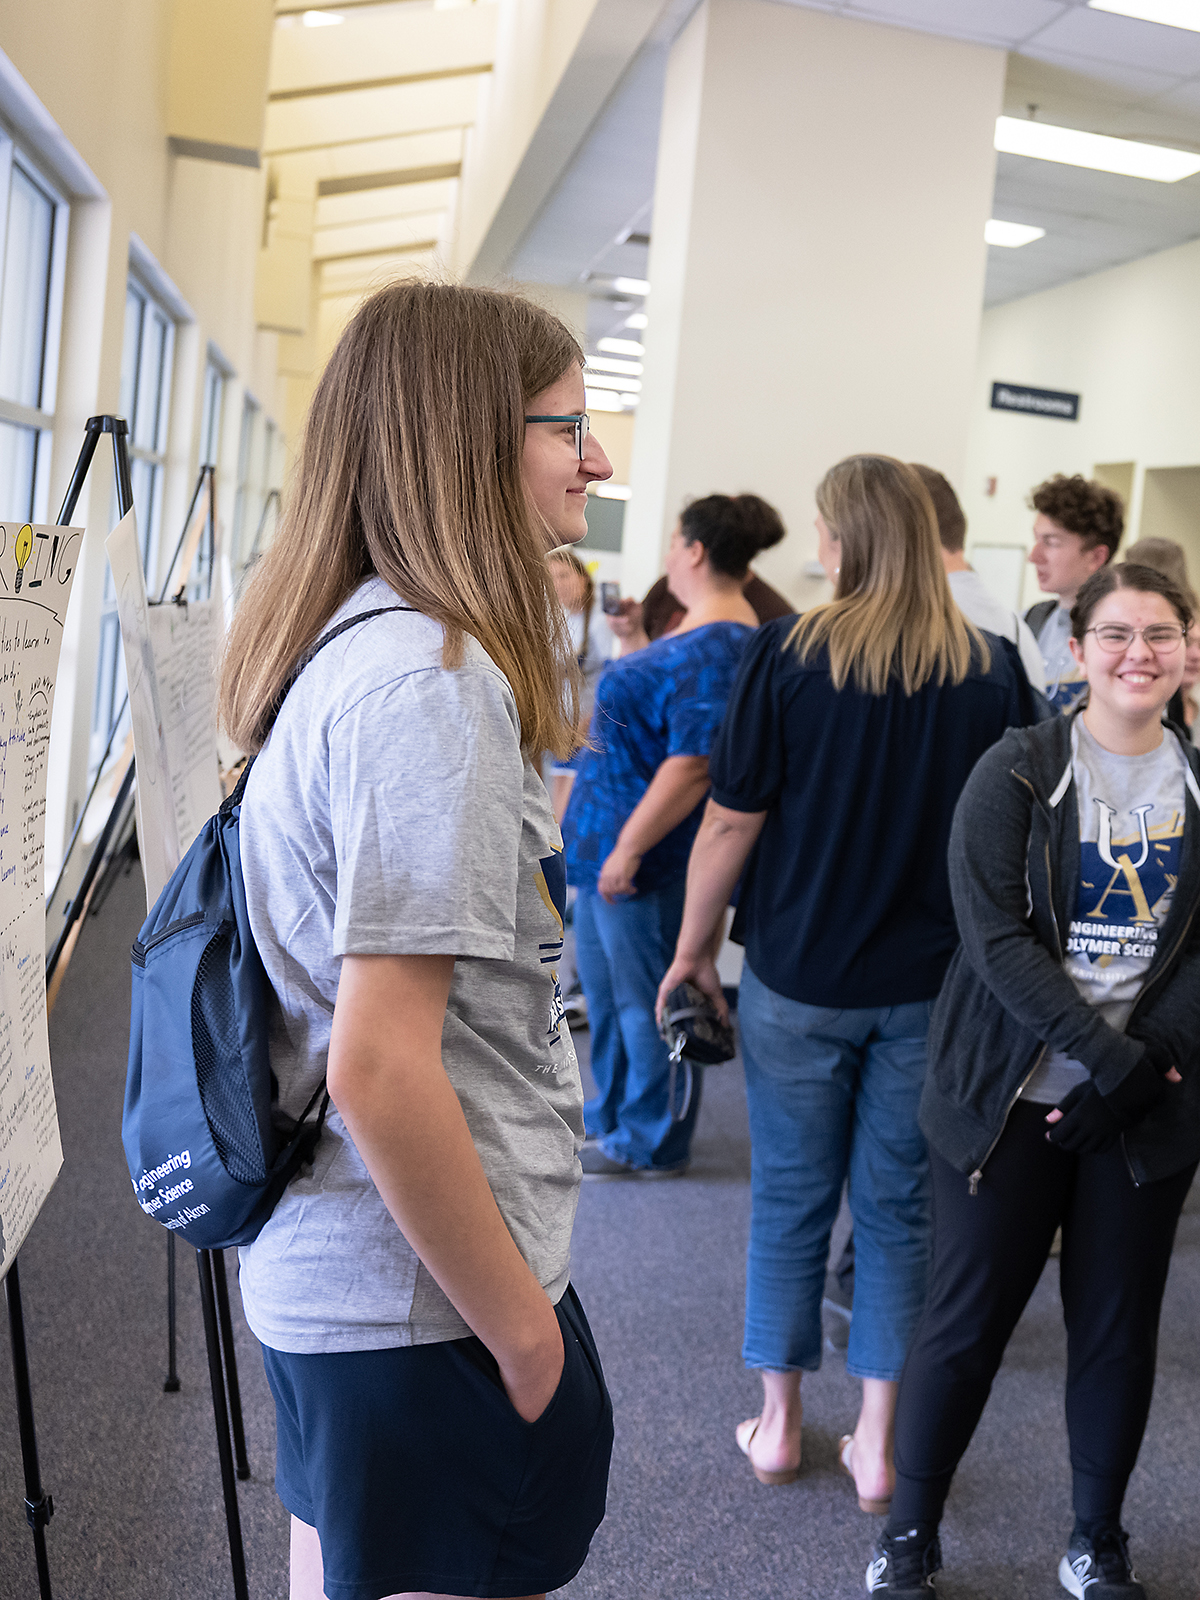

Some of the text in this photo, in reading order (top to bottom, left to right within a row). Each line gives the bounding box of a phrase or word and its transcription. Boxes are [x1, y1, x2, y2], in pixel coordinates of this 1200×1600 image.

[535, 1063, 559, 1074] THE
[158, 1177, 195, 1205] Science
[183, 1203, 211, 1222] Akron
